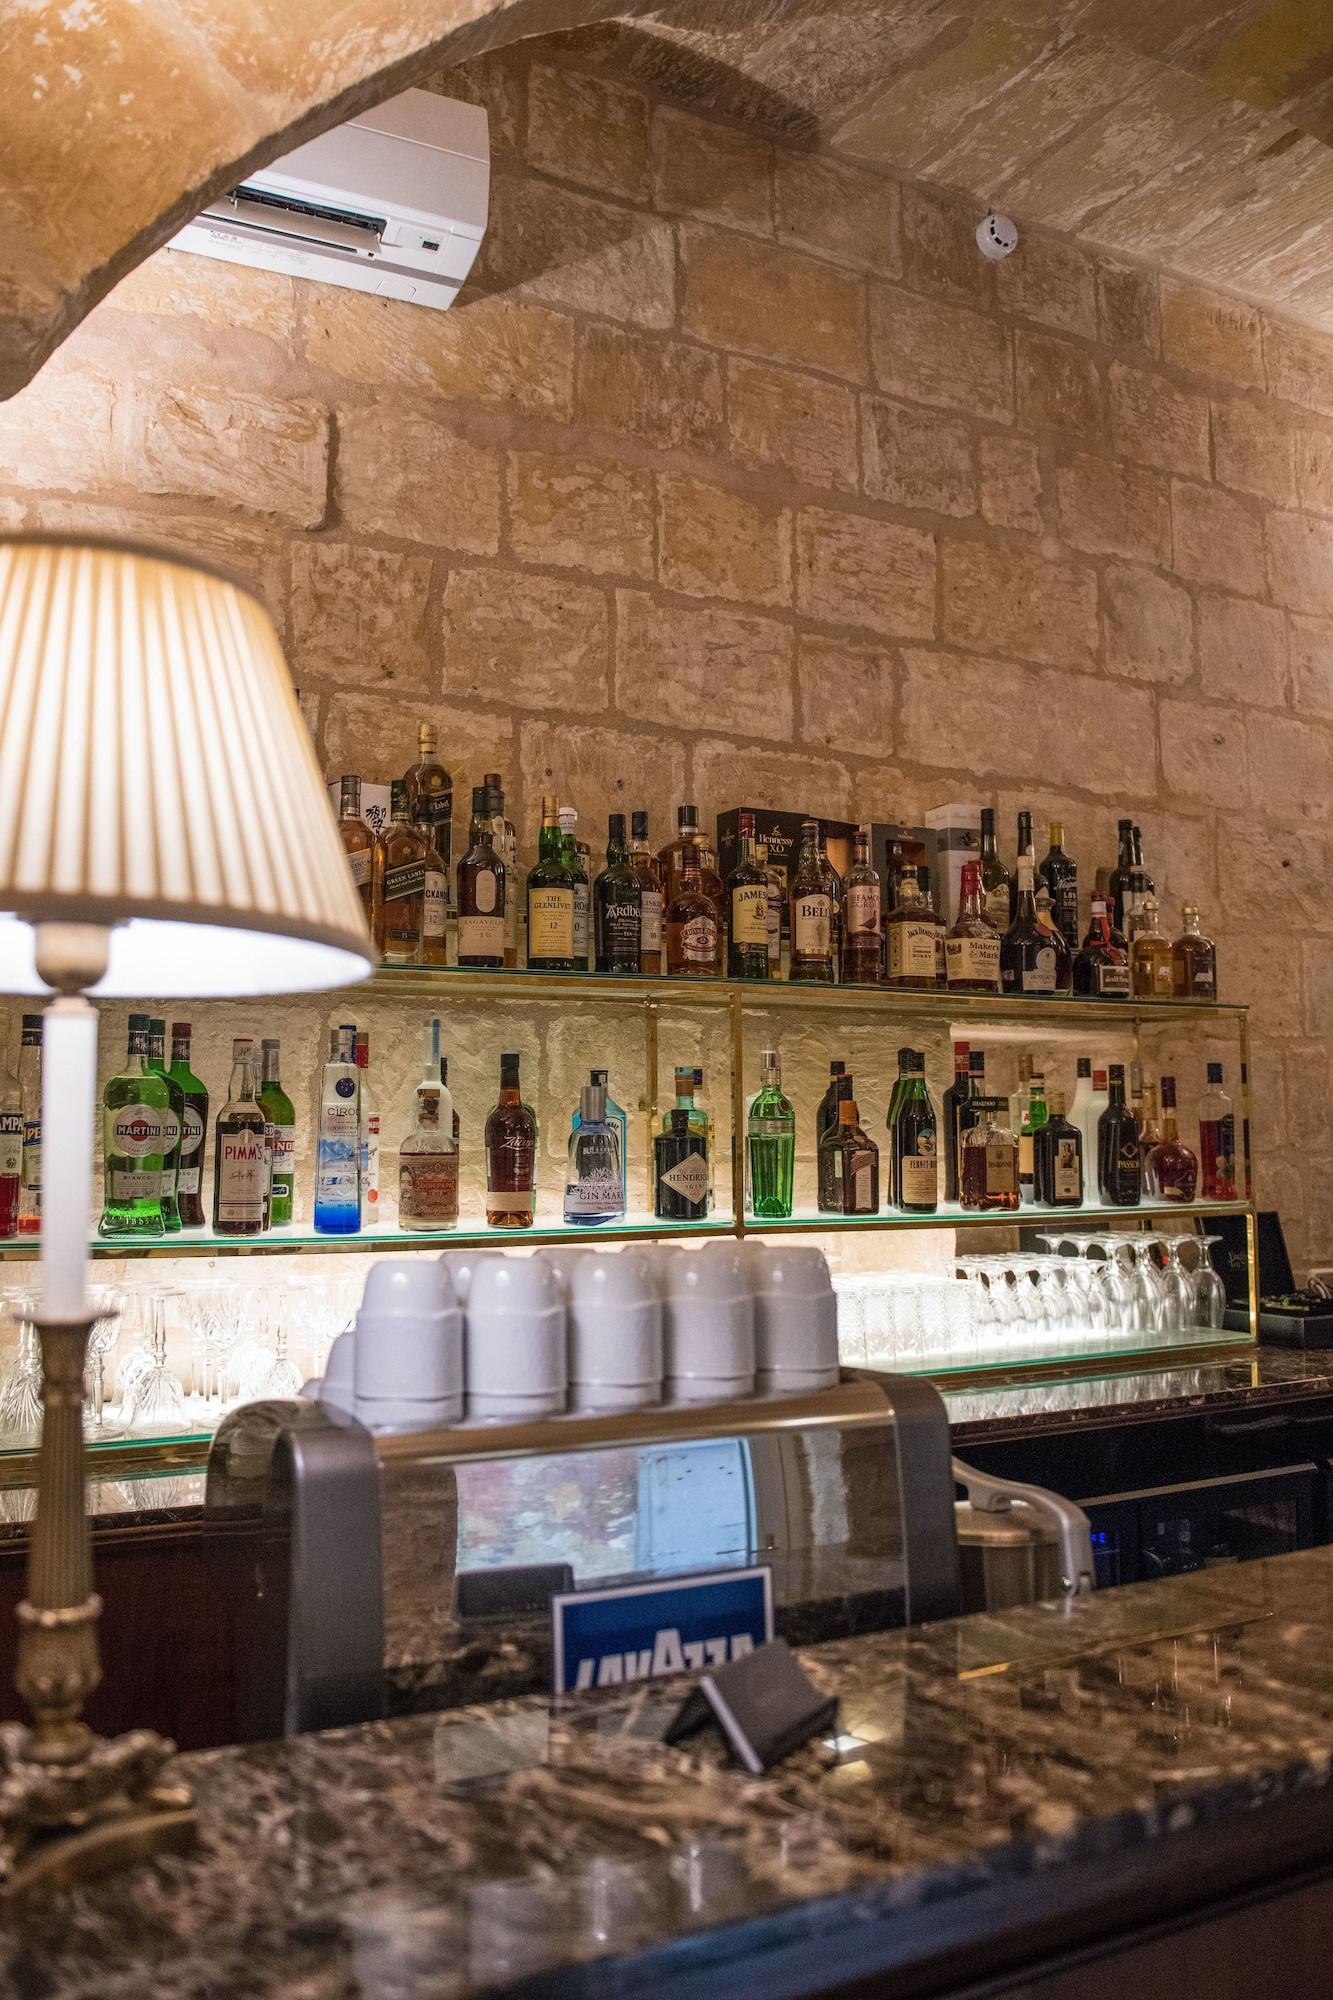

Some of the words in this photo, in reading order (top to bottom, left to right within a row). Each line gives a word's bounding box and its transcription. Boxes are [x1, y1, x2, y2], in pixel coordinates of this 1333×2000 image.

[759, 833, 793, 847] Hennessy
[769, 844, 785, 853] XO
[386, 874, 407, 886] GREEN
[117, 1125, 160, 1136] MARTINI
[225, 1143, 263, 1160] PIMM'S
[580, 1192, 600, 1201] GIN
